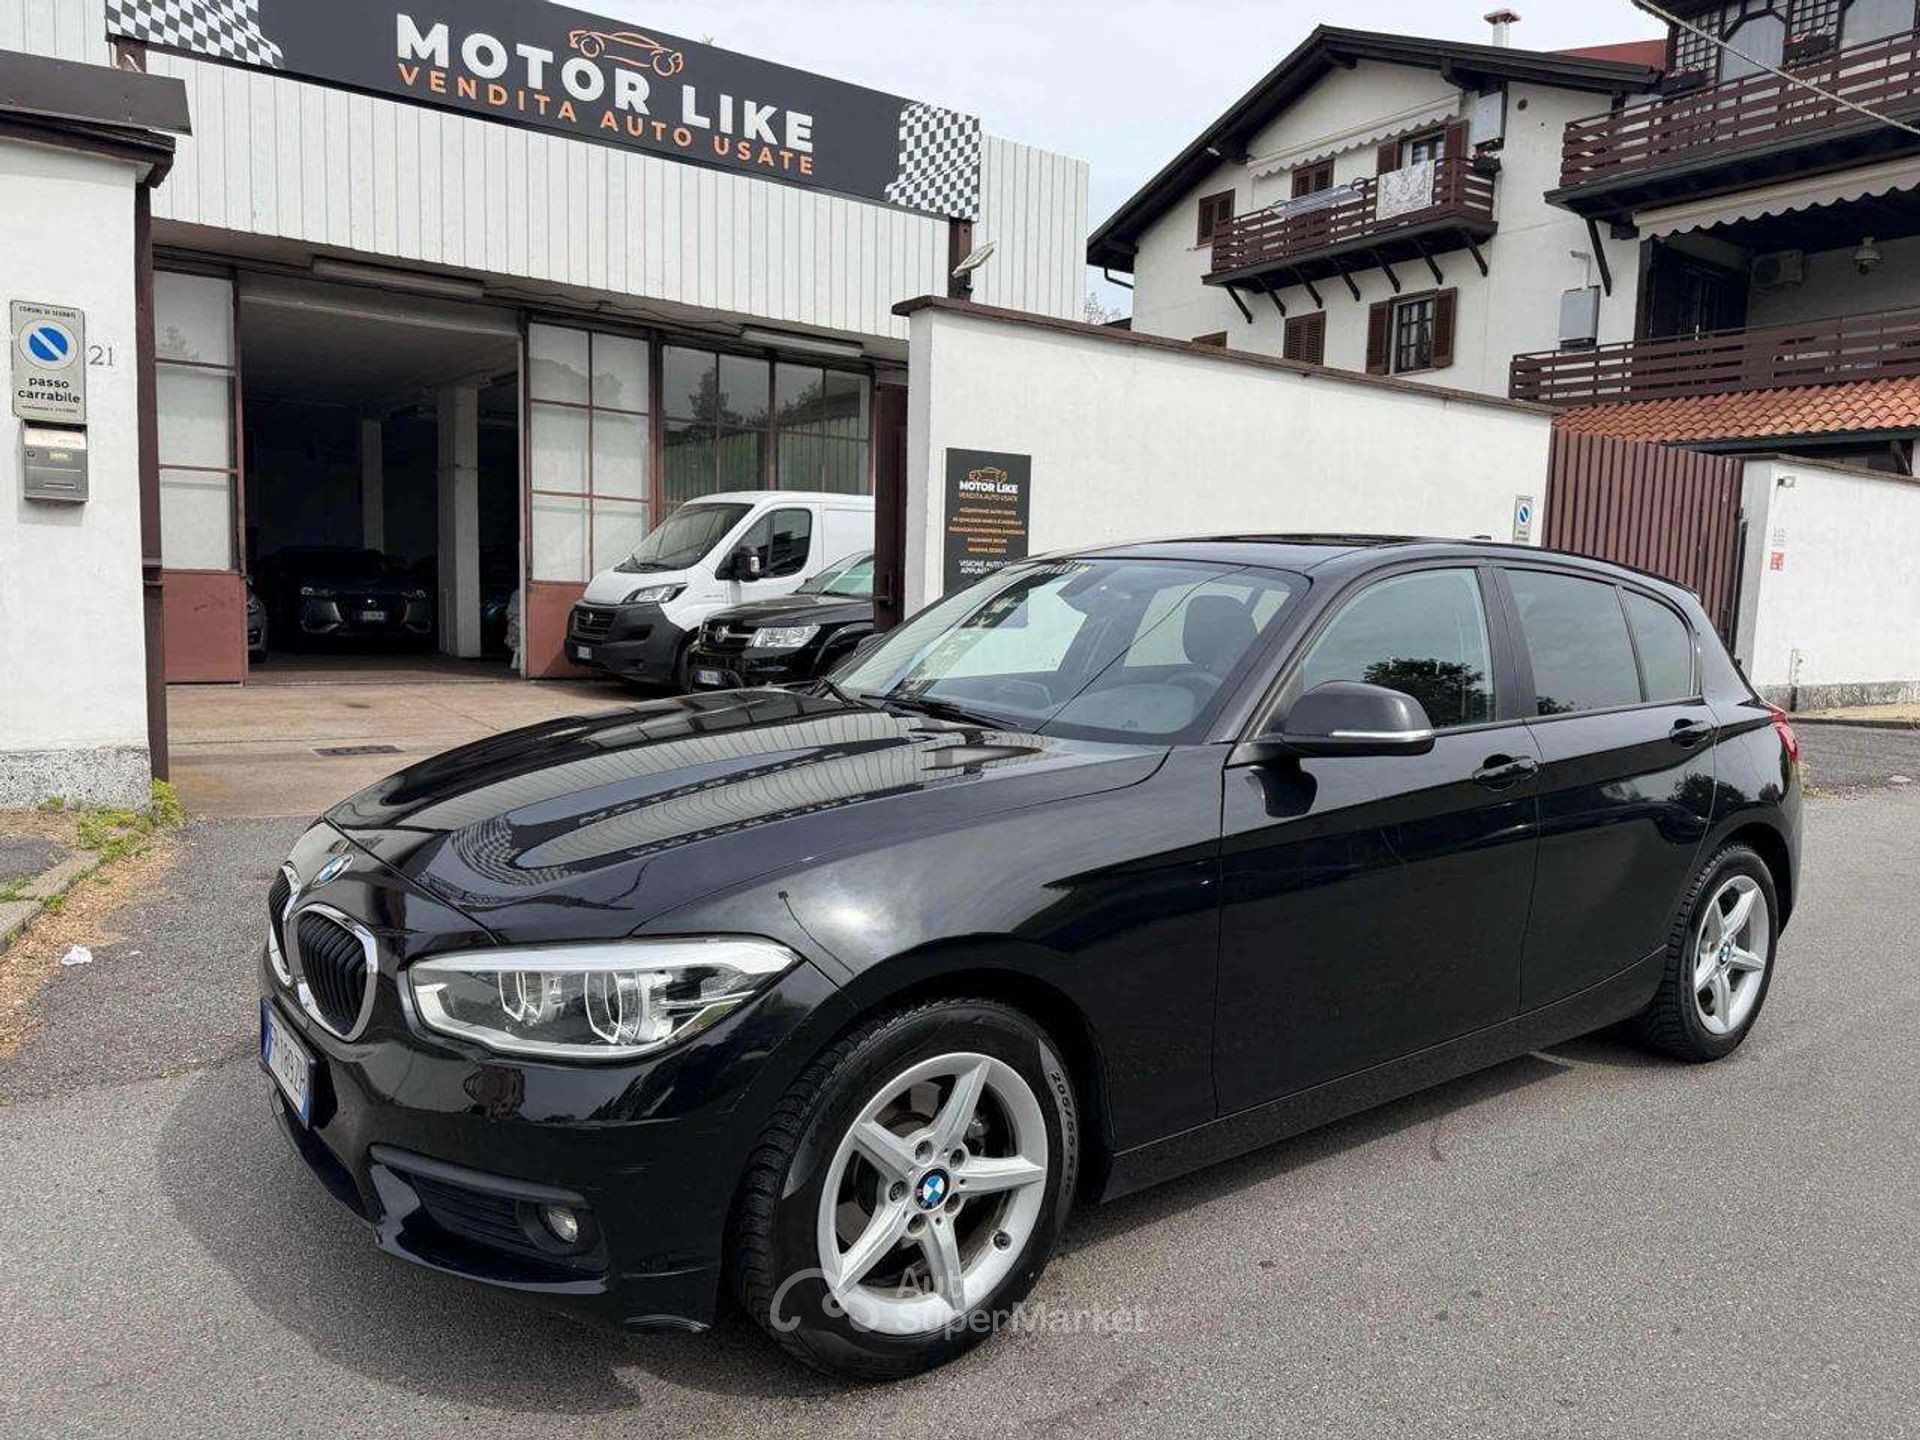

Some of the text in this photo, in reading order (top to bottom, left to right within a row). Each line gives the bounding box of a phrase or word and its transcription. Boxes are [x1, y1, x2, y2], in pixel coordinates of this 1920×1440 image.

[397, 13, 814, 152] MOTOR LIKE
[397, 63, 813, 176] VENDITA AUTO USATE
[88, 345, 114, 366] 21
[28, 377, 70, 389] passo
[18, 389, 81, 403] carrabile
[959, 480, 1019, 494] MOTOR LIKE
